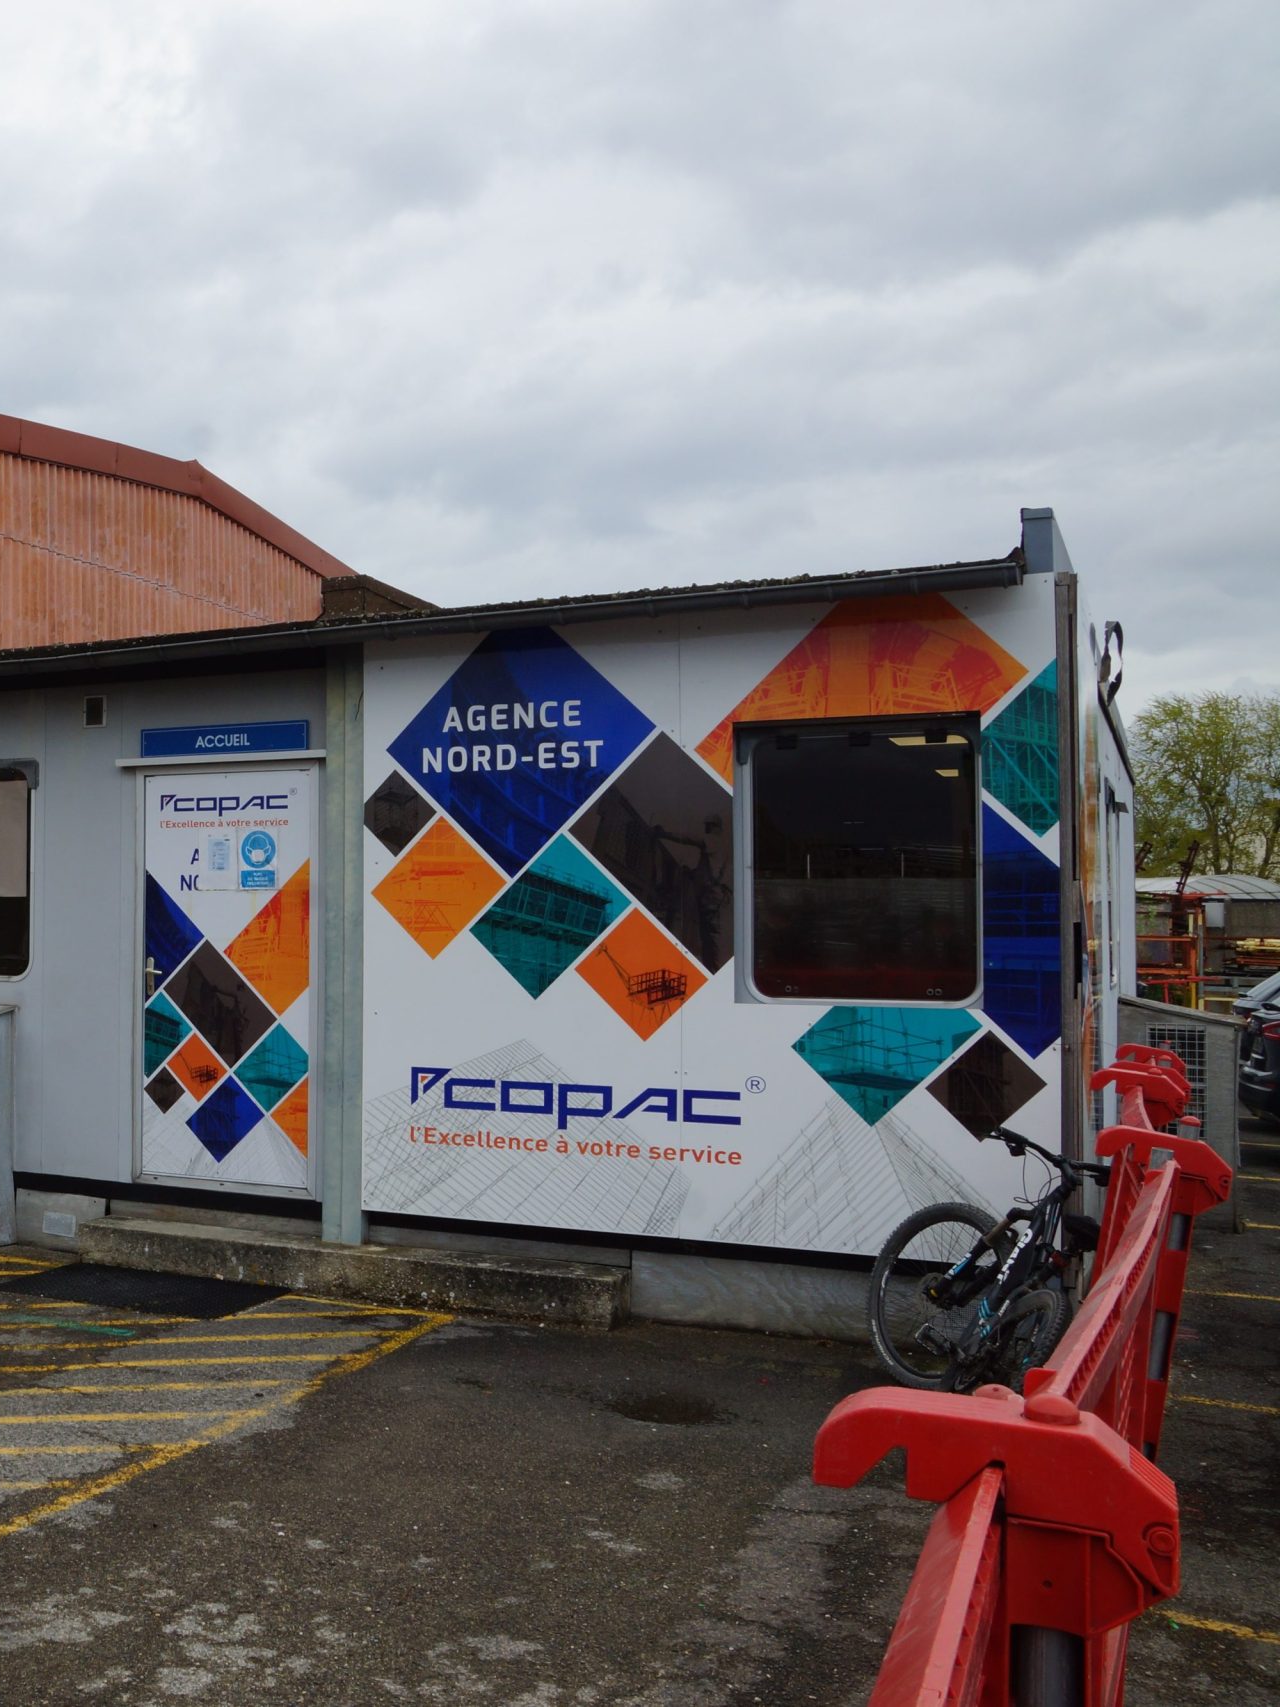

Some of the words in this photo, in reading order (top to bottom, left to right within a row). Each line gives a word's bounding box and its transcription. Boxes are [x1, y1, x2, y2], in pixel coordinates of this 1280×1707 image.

[442, 700, 582, 733] AGENCE
[195, 733, 250, 748] ACCUEIL
[421, 739, 605, 774] NORD-EST
[160, 819, 215, 829] l'Excellence
[226, 819, 251, 828] votre
[253, 818, 289, 827] service
[409, 1125, 548, 1154] l'Excellence
[555, 1132, 570, 1155] à
[577, 1137, 641, 1160] votre
[648, 1142, 743, 1167] service
